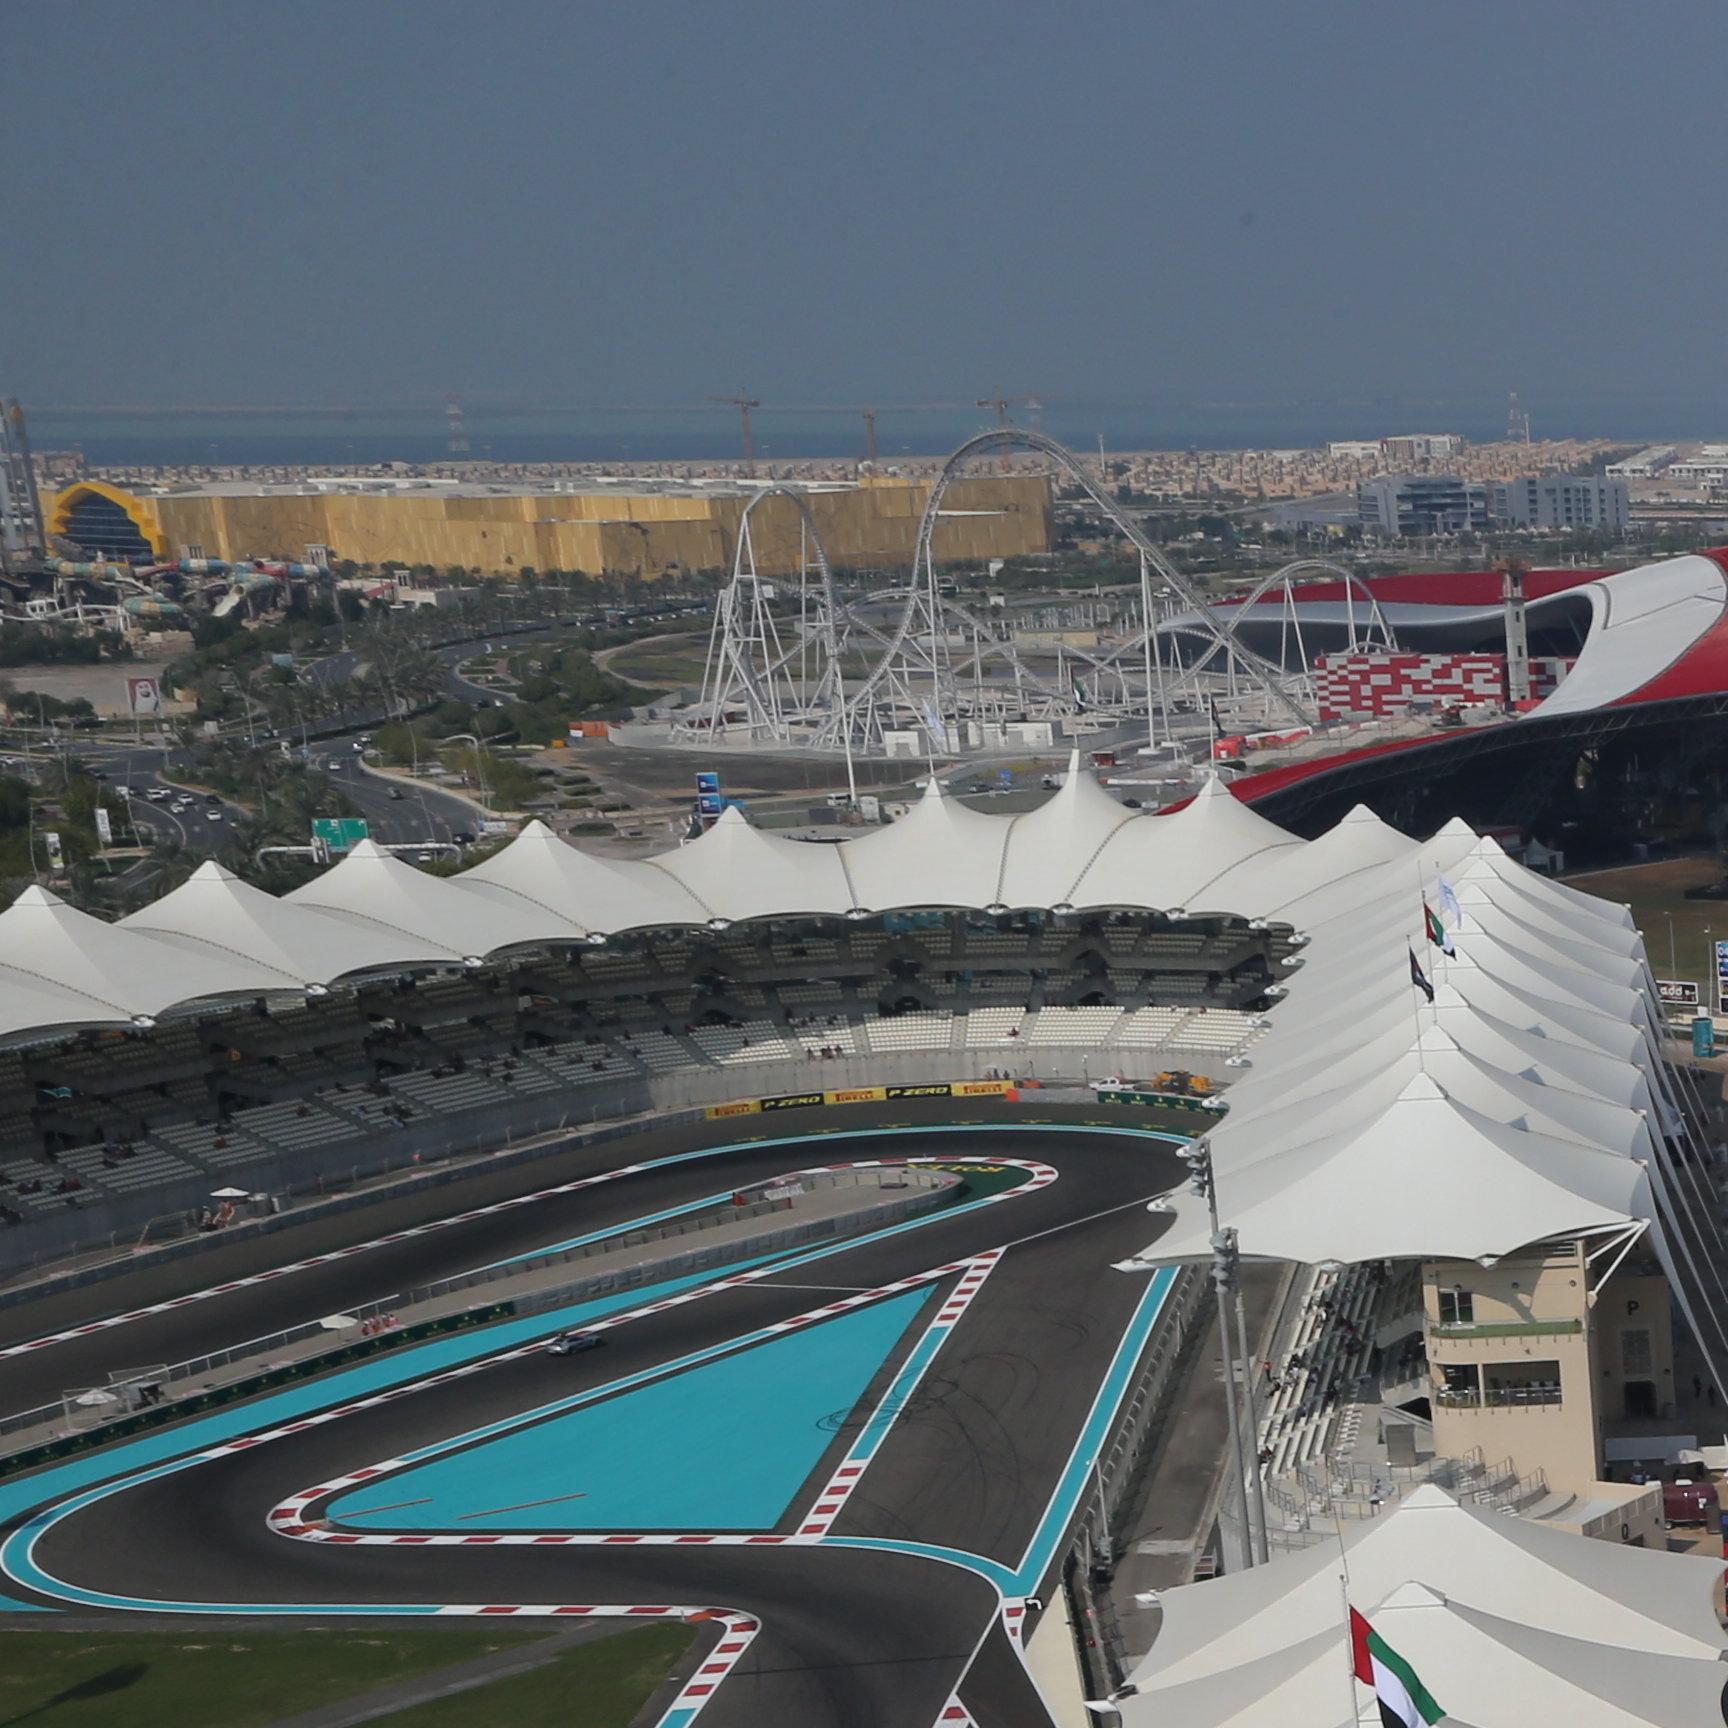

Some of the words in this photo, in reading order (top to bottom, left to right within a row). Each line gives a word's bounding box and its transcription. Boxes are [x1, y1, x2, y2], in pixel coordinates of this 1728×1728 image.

[902, 1086, 948, 1096] ZERO
[963, 1084, 1002, 1095] PIRELLI
[777, 1095, 821, 1107] ZERO
[1627, 1301, 1639, 1316] P
